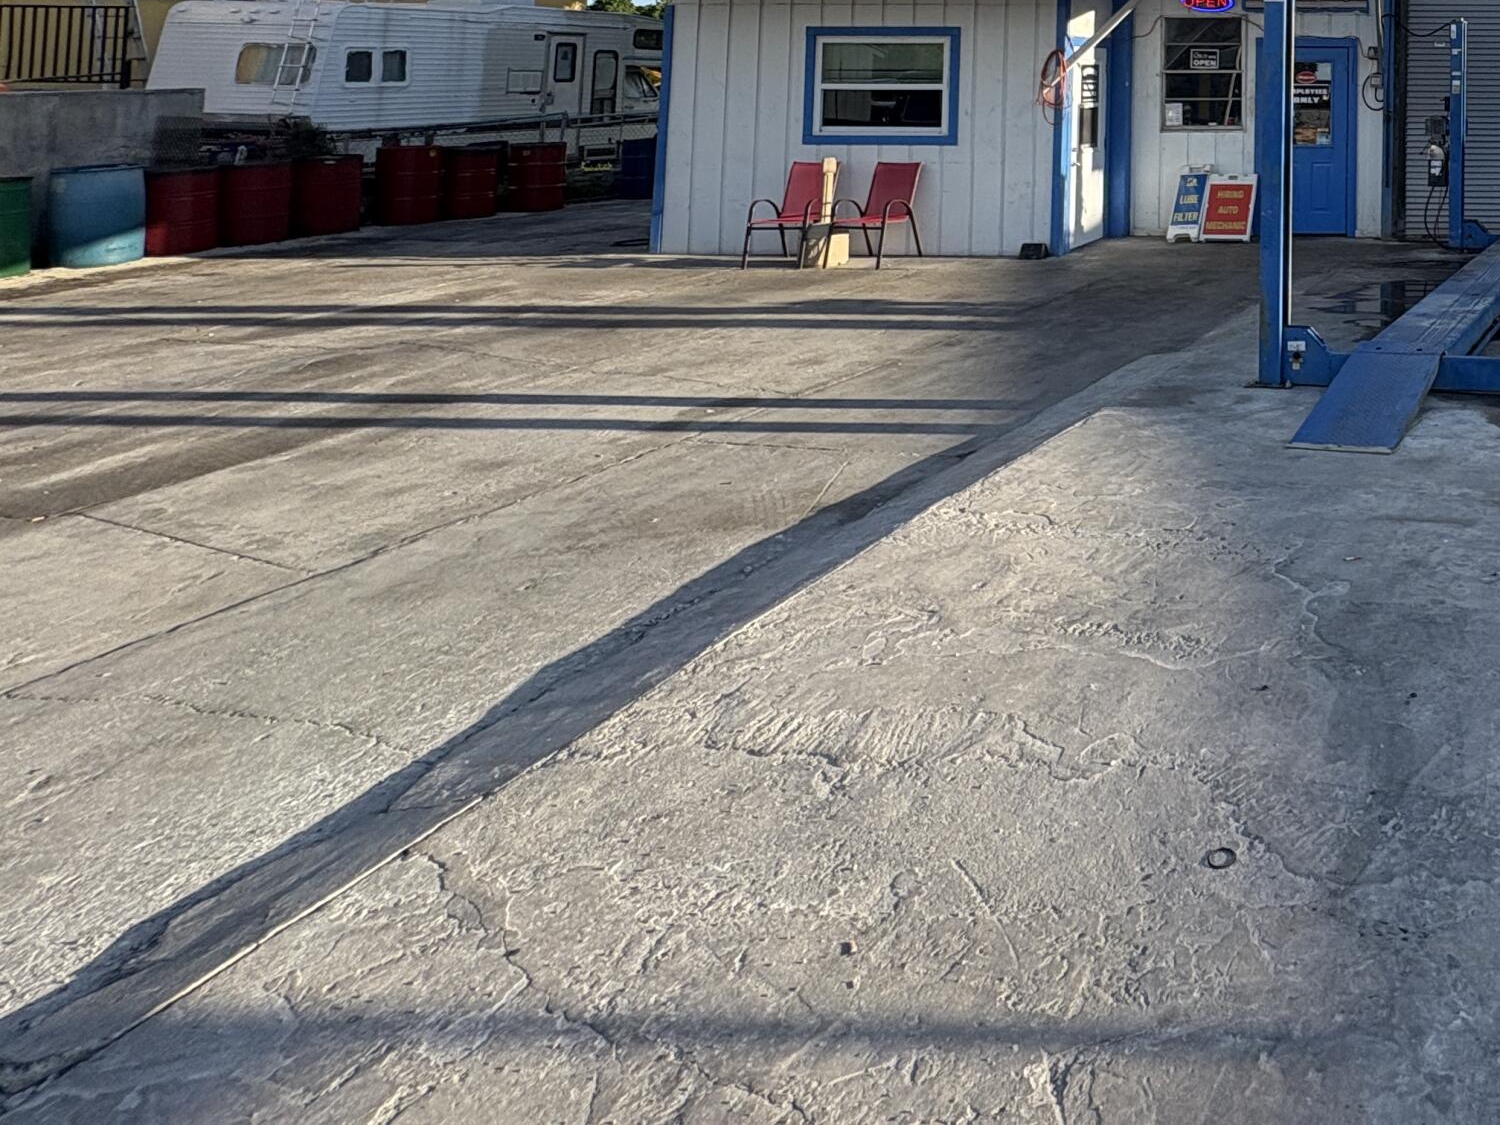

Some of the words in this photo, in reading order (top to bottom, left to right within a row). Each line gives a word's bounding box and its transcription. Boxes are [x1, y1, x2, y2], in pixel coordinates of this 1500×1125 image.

[1193, 59, 1216, 67] OPEN
[1294, 96, 1320, 104] ONLY
[1180, 195, 1198, 204] LUBE
[1218, 206, 1239, 214] AUTO
[1173, 212, 1198, 221] FILTER
[1206, 221, 1246, 230] MECHANIC
